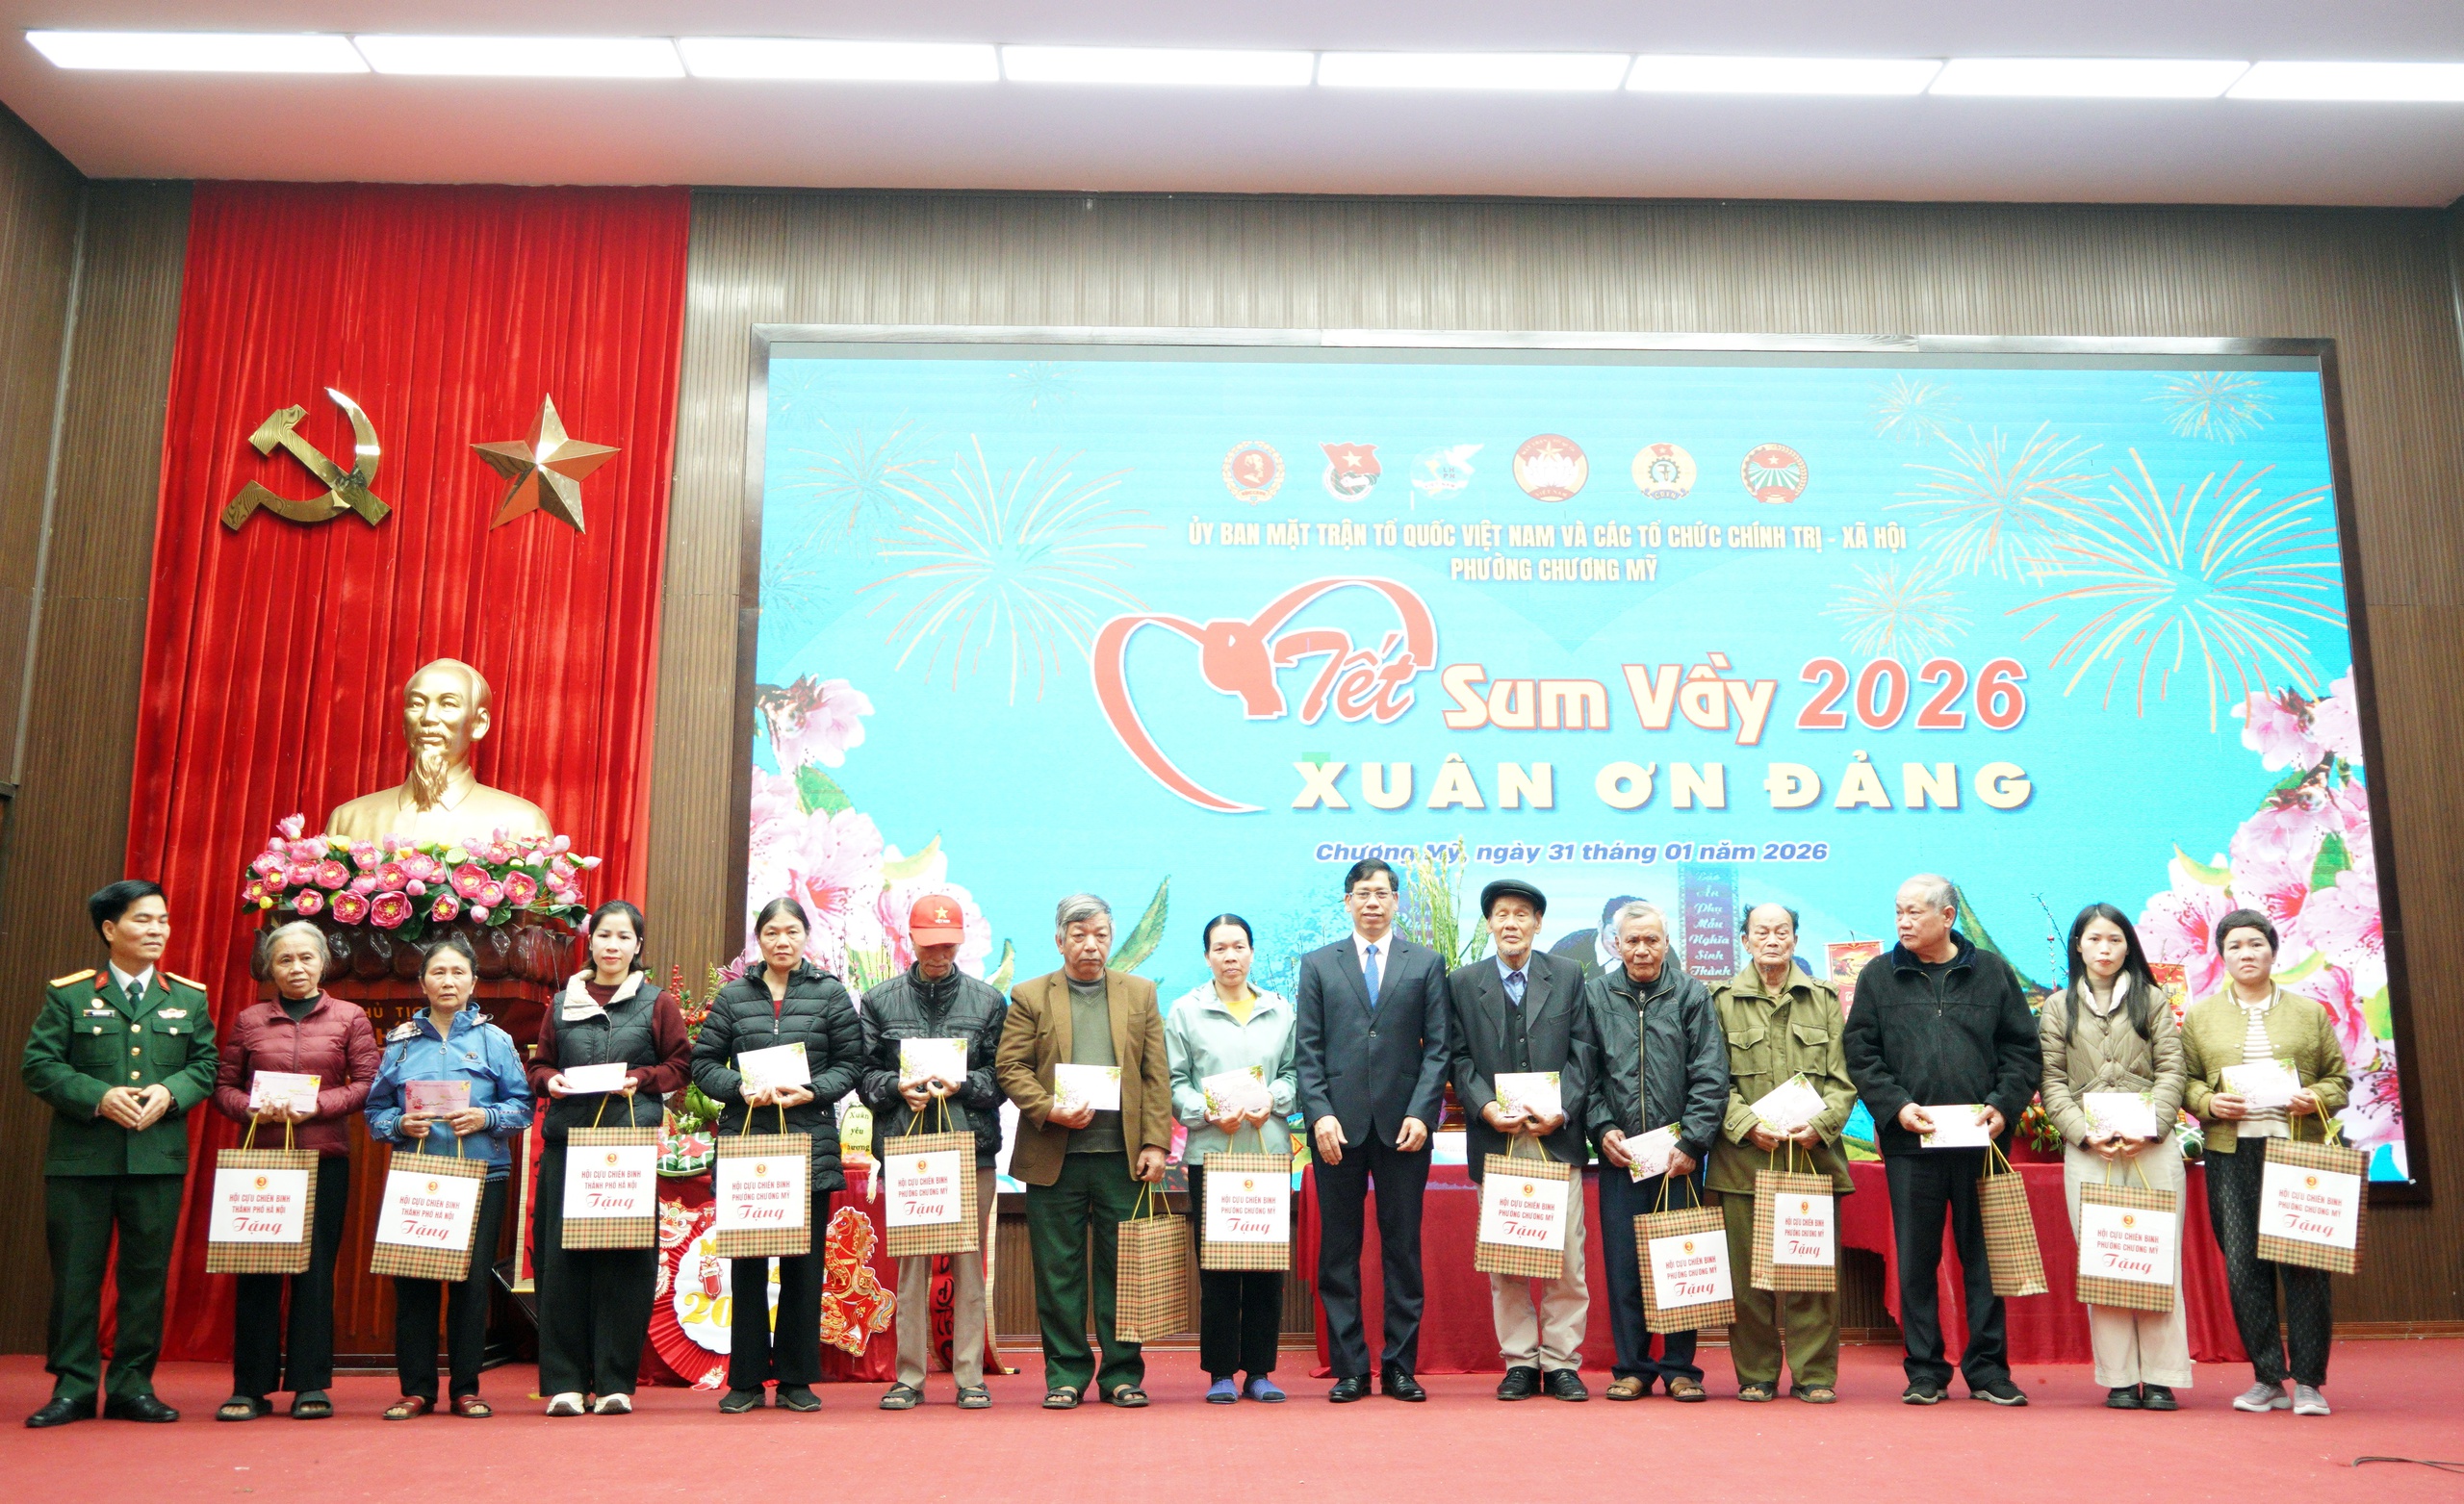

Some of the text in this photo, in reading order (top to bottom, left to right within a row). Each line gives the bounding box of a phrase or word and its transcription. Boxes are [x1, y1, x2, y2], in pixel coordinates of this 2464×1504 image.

[1190, 516, 1214, 546] ỦY
[1220, 523, 1260, 546] BAN
[1267, 519, 1311, 550] MẶT
[1317, 519, 1367, 550] TRẬN
[1373, 518, 1398, 547] TỔ
[1403, 519, 1456, 548] QUỐC
[1462, 520, 1502, 551] VIỆT
[1508, 524, 1555, 548] NAM
[1561, 520, 1588, 548] VÀ
[1593, 520, 1631, 548] CÁC
[1638, 520, 1662, 548] TỔ
[1667, 520, 1722, 548] CHỨC
[1728, 521, 1785, 548] CHÍNH
[1792, 525, 1822, 553] TRỊ
[1842, 521, 1868, 549] XÃ
[1874, 521, 1907, 553] HỘI
[1450, 551, 1657, 581] PHƯỜNG CHƯƠNG MỸ
[1273, 628, 2026, 746] Tết Sum Vầy 2026
[1293, 748, 2033, 811] XUÂN ƠN ĐẢNG
[1316, 843, 1415, 864] Chương
[1476, 843, 1541, 863] ngày
[1547, 844, 1575, 860] 31
[1581, 843, 1655, 863] tháng
[1664, 844, 1691, 860] 01
[1699, 843, 1756, 860] năm
[1762, 844, 1828, 860] 2026
[1694, 949, 1724, 960] Sinh
[851, 1127, 864, 1135] yêu
[581, 1169, 592, 1181] HỘI
[898, 1178, 907, 1189] HỘI
[936, 1176, 948, 1185] BINH
[732, 1180, 742, 1192] HỘI
[228, 1192, 240, 1204] HỘI
[275, 1194, 291, 1203] BINH
[399, 1195, 410, 1206] HỘI
[445, 1200, 460, 1210] BINH
[585, 1192, 634, 1211] Tặng
[1220, 1193, 1231, 1205] HỘI
[1499, 1197, 1509, 1208] HỘI
[1541, 1203, 1555, 1211] BINH
[2278, 1187, 2290, 1199] HỘI
[2326, 1197, 2343, 1207] BINH
[737, 1204, 784, 1221] Tặng
[904, 1201, 944, 1217] Tặng
[232, 1216, 283, 1236] Tặng
[400, 1219, 449, 1240] Tặng
[1226, 1217, 1270, 1235] Tặng
[1502, 1220, 1548, 1241] Tặng
[2283, 1213, 2334, 1237] Tặng
[2097, 1228, 2108, 1239] HỘI
[2143, 1235, 2159, 1243] BINH
[1665, 1259, 1675, 1269] HỘI
[1704, 1255, 1716, 1263] BINH
[2102, 1253, 2152, 1275] Tặng
[1674, 1282, 1715, 1297] Tặng
